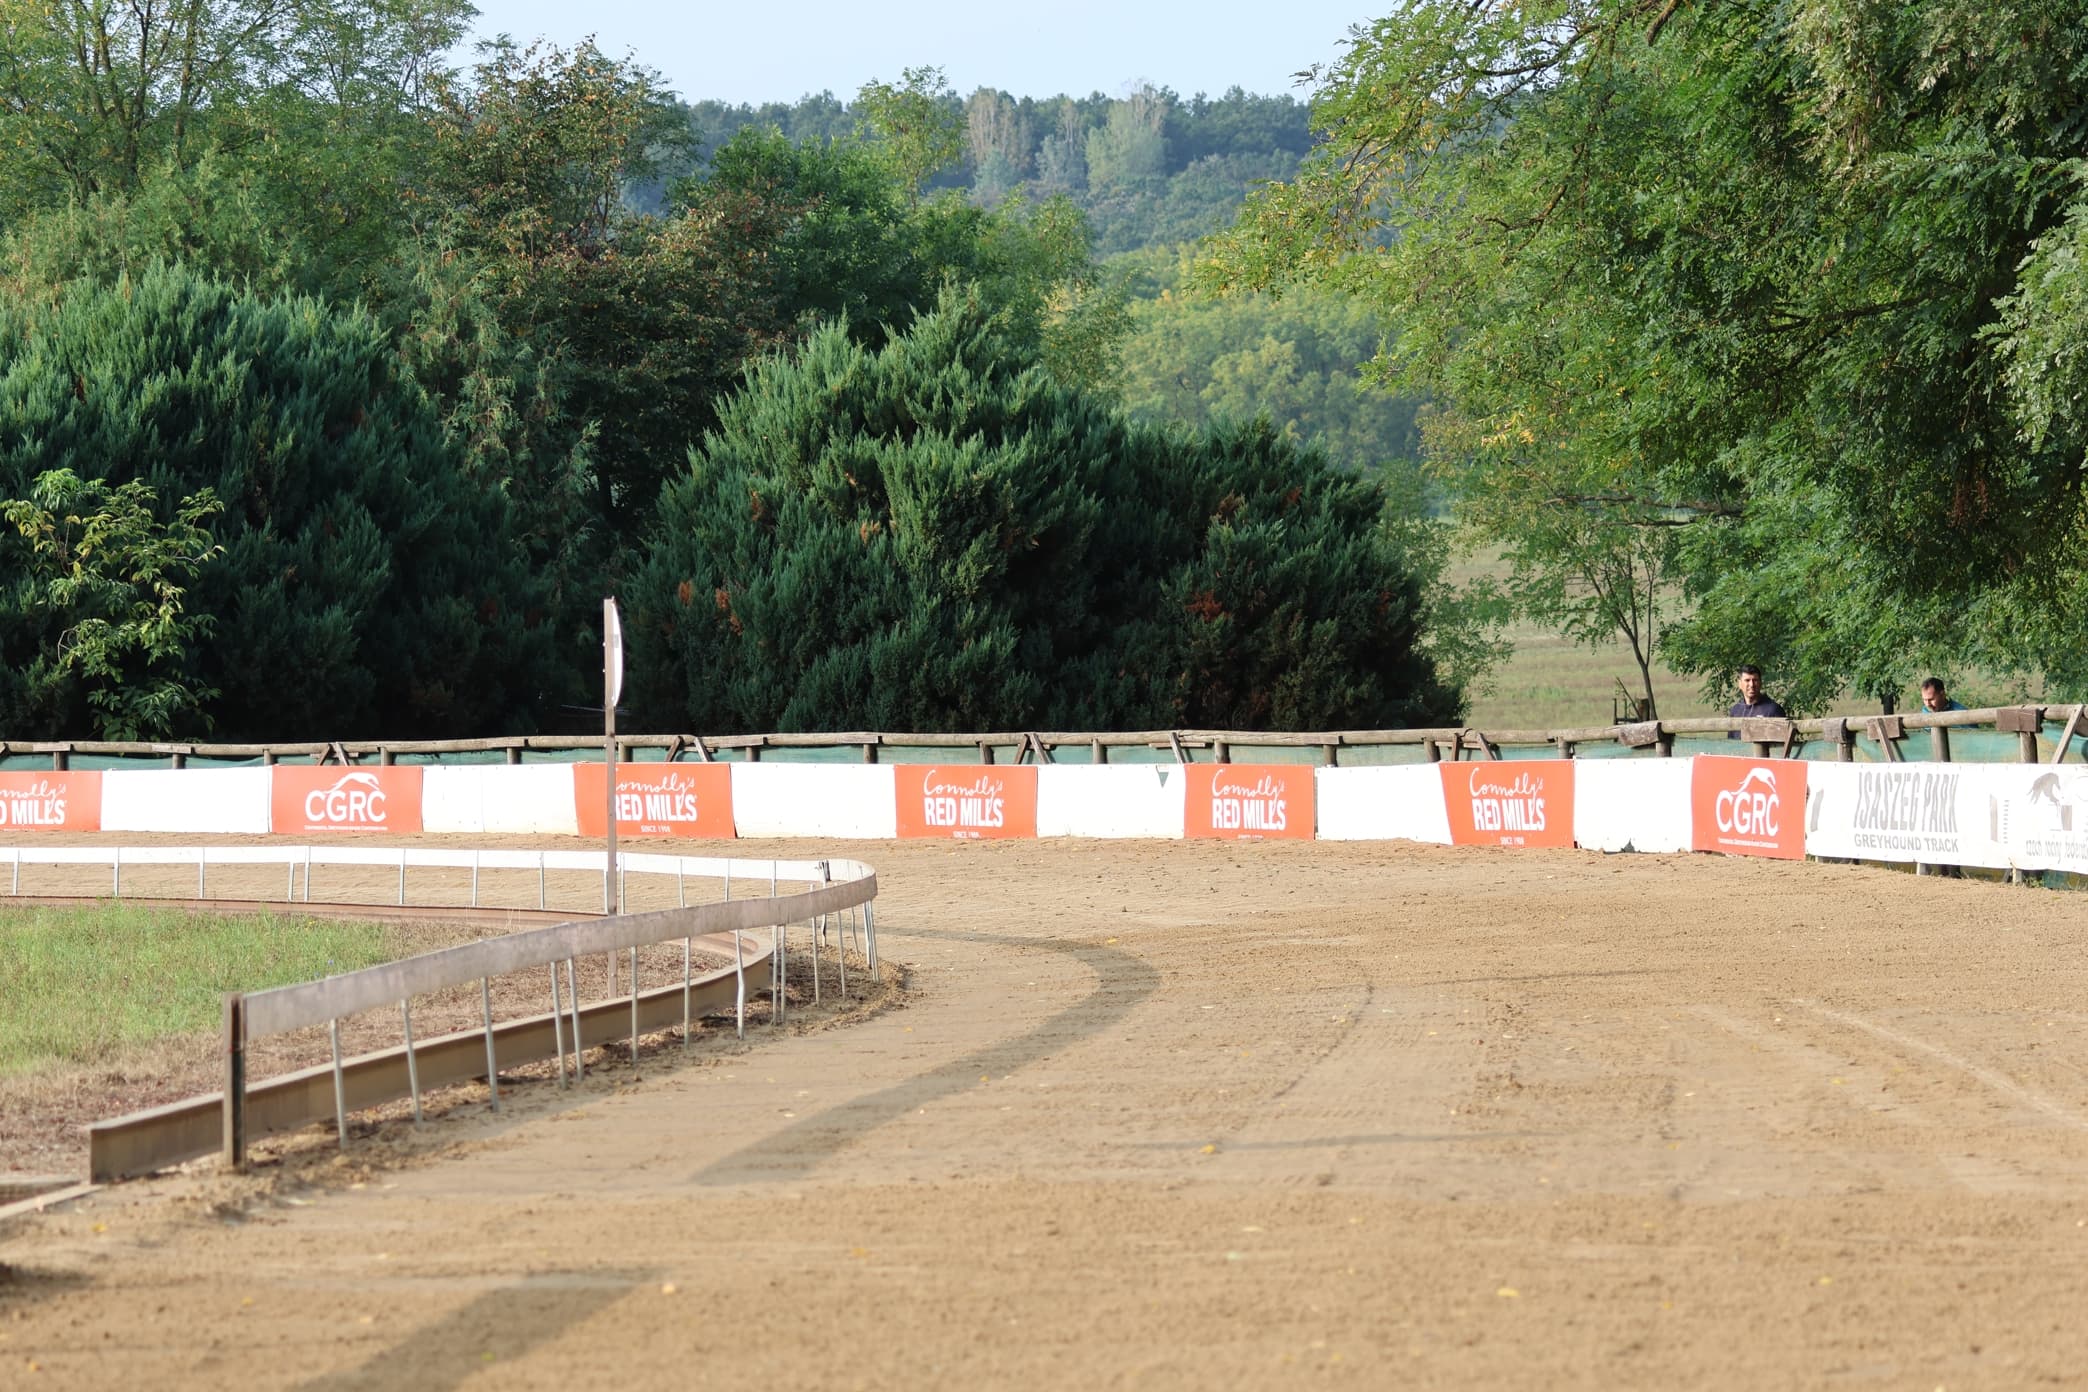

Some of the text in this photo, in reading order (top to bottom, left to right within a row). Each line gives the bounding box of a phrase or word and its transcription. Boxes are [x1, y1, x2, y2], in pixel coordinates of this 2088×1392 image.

[616, 773, 696, 805] onnolly's
[923, 769, 1004, 812] Connolly's
[1212, 768, 1285, 812] Connolly's
[1469, 767, 1544, 811] Connolly's
[1853, 771, 1921, 832] ISASZEG
[1921, 773, 1960, 833] PARK
[11, 799, 65, 825] MILLS
[305, 790, 386, 822] CGRC
[645, 794, 698, 822] MILLS
[924, 797, 1004, 828] RED MILLS
[1212, 798, 1286, 831] RED MILLS
[1472, 798, 1545, 831] RED MILLS
[1715, 789, 1780, 837] CGRC
[1854, 833, 1960, 853] GREYHOUND TRACK
